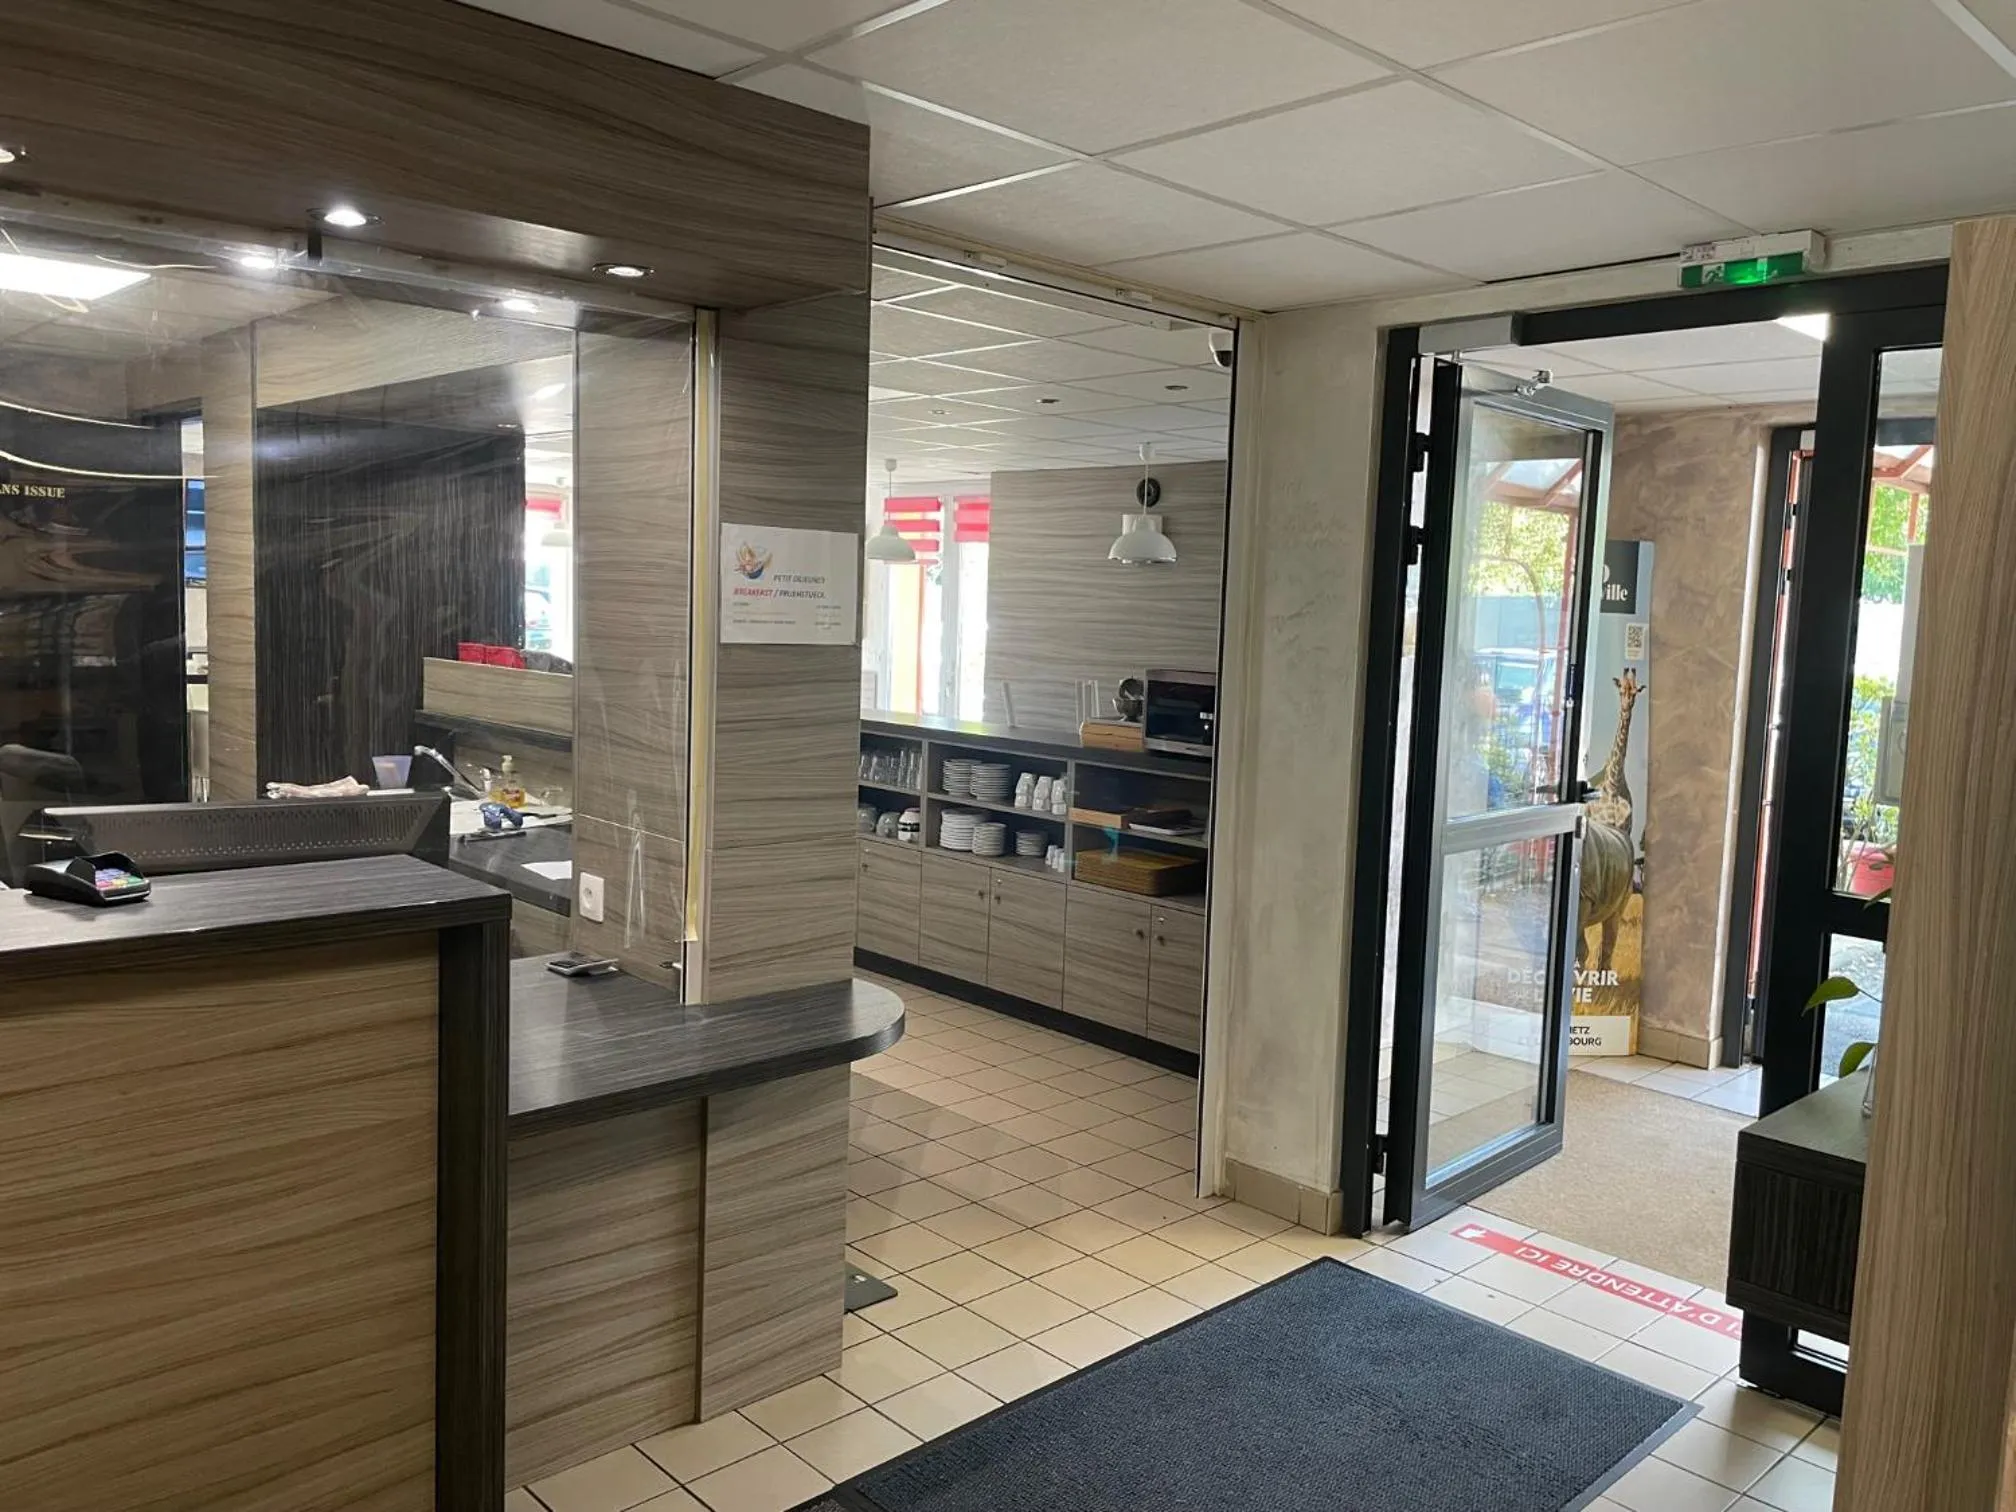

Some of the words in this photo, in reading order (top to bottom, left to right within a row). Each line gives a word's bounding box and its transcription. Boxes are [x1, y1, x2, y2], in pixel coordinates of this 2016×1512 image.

[24, 484, 65, 498] ISSUE
[733, 587, 773, 597] BREAKFAST
[1514, 1247, 1550, 1266] ICI
